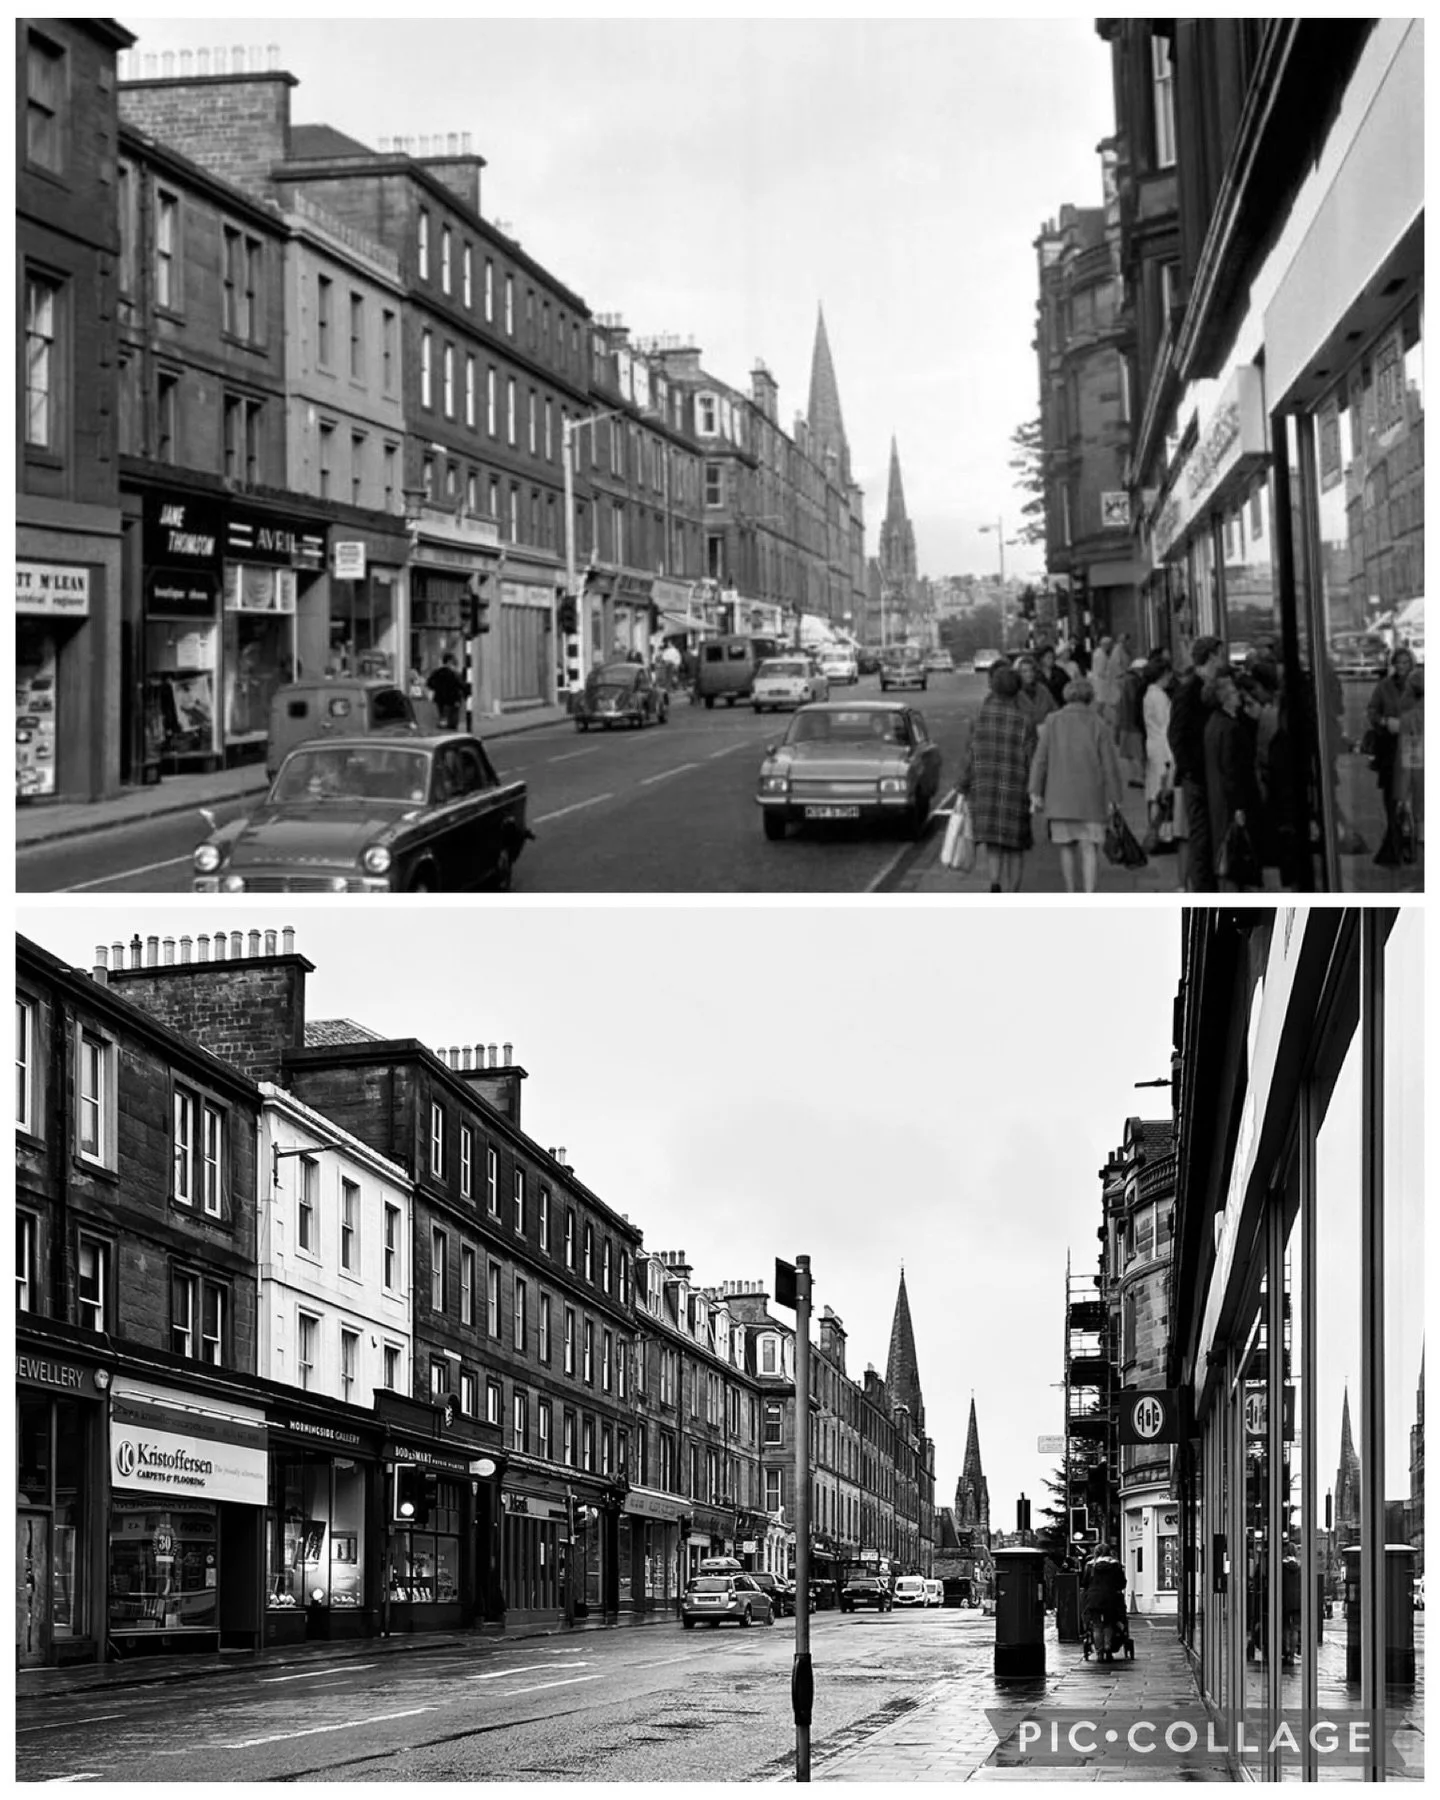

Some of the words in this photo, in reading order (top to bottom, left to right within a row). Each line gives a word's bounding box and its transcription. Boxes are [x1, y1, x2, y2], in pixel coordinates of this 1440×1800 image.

[159, 503, 186, 528] JANE
[257, 527, 299, 555] AVRIL
[289, 1420, 335, 1439] MORNINGSIDE
[137, 1442, 213, 1475] Kristoffersen
[137, 1469, 166, 1482] CARPETS
[173, 1476, 206, 1488] FLOORING
[158, 1535, 171, 1550] 30
